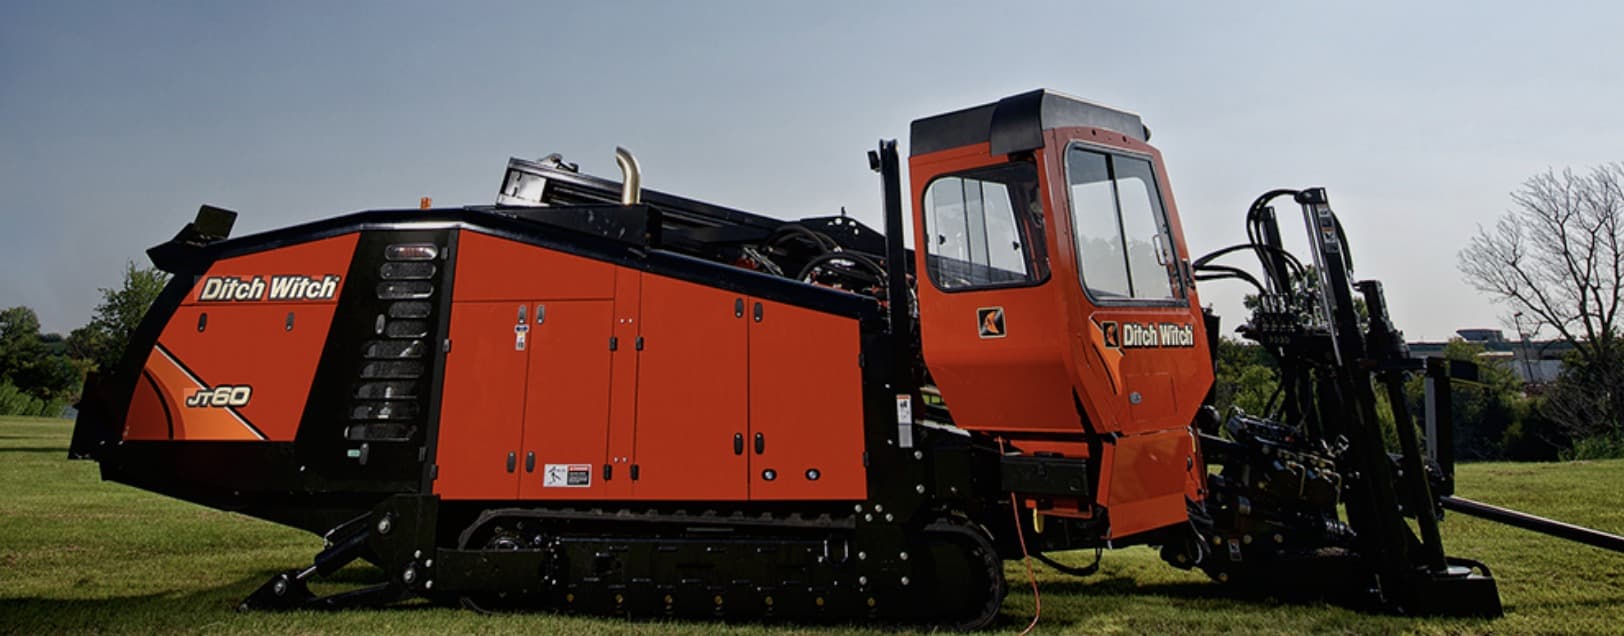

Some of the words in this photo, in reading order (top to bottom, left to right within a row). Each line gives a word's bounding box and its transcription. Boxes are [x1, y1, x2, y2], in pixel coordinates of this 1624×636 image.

[200, 276, 266, 300] Ditch
[269, 275, 340, 299] Witch
[1123, 323, 1158, 346] Ditch
[1159, 323, 1194, 346] Witch
[187, 386, 251, 406] JT60
